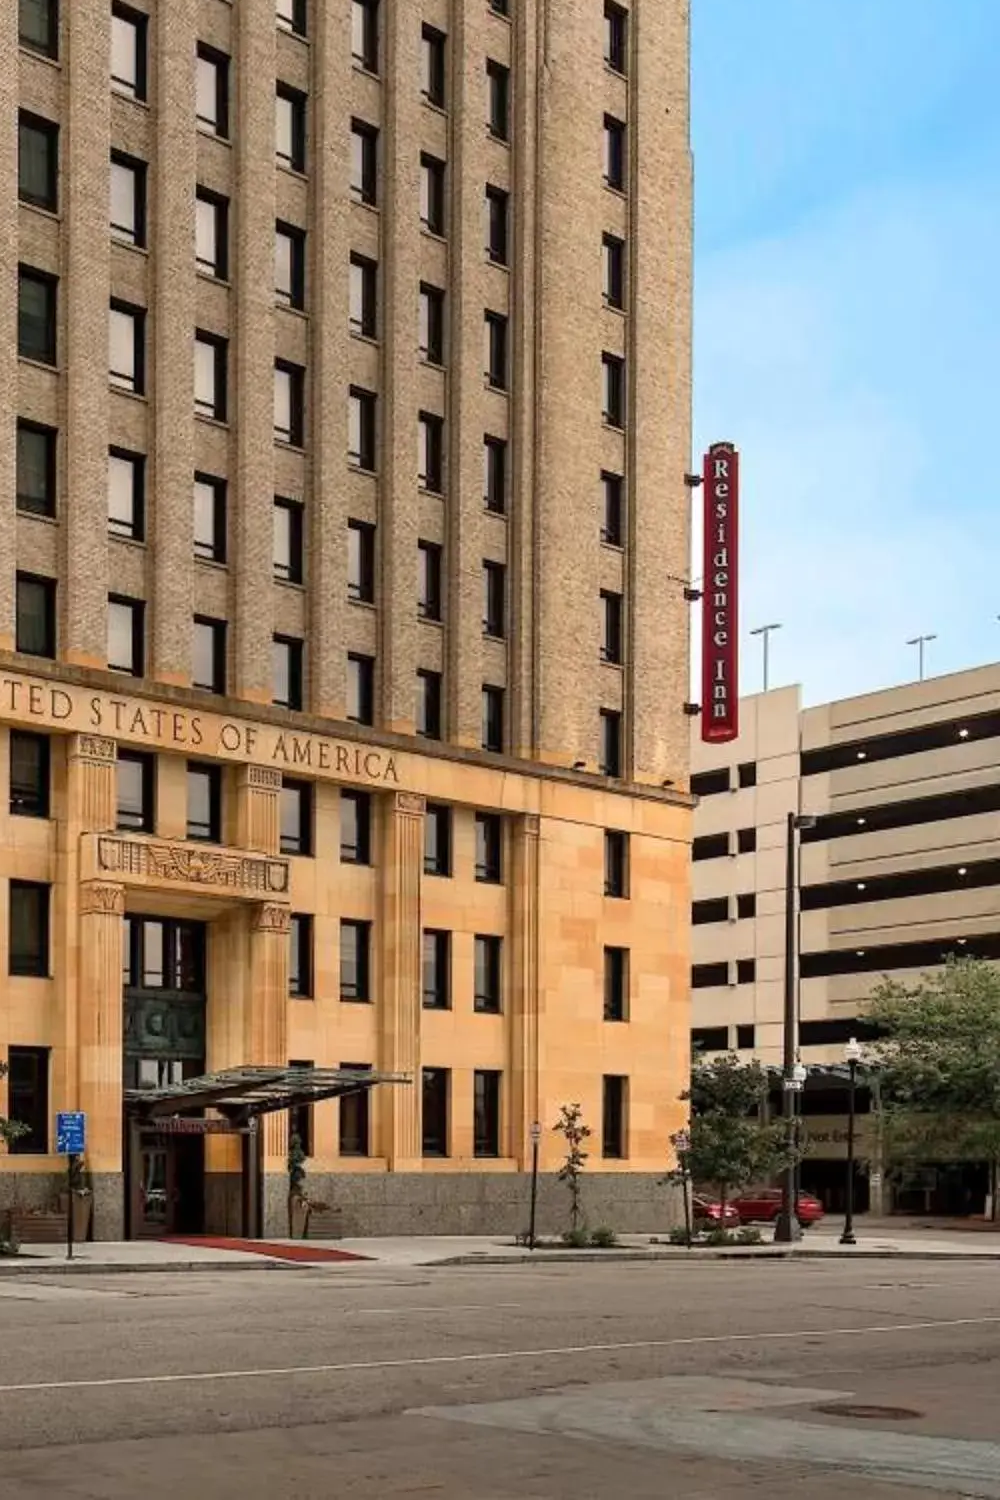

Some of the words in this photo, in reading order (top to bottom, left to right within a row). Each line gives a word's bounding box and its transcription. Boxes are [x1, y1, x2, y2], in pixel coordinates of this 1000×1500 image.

[713, 459, 729, 646] Residence
[713, 659, 727, 717] Inn
[90, 697, 203, 745] STATES
[220, 723, 258, 754] OF
[271, 734, 399, 783] AMERICA
[832, 1129, 864, 1143] Ener
